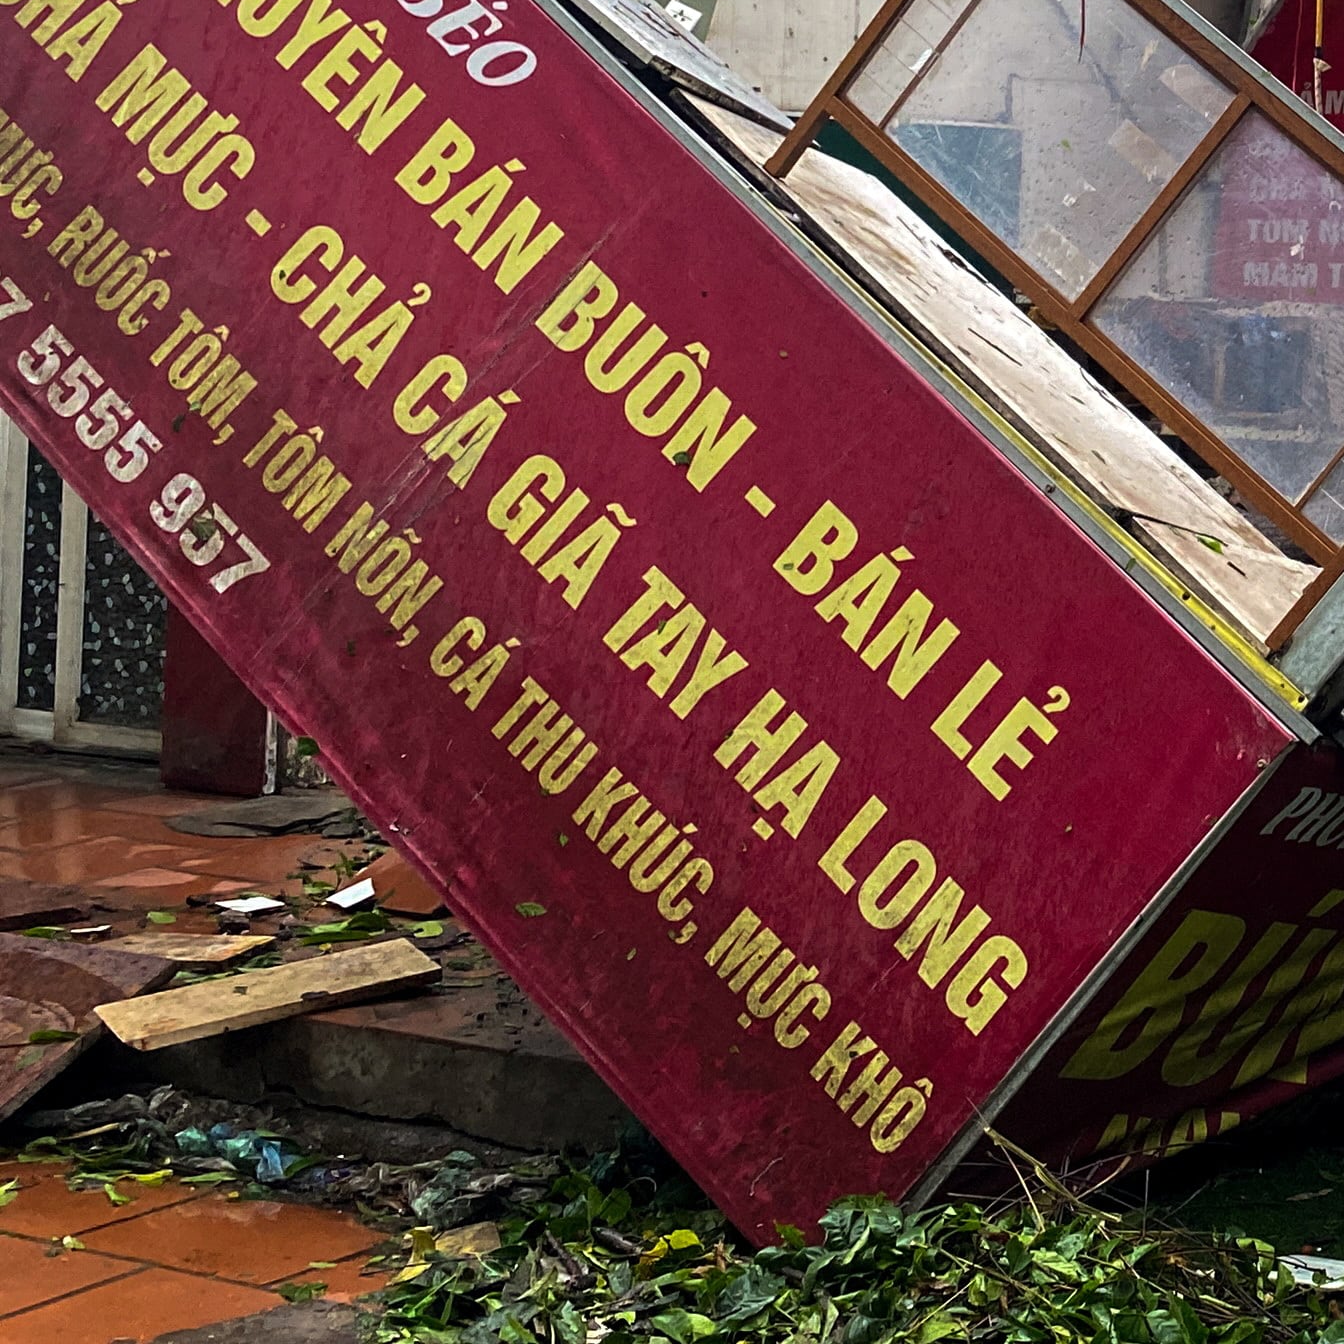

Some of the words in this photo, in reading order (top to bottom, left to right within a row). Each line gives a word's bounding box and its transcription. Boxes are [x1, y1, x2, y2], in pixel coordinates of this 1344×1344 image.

[15, 323, 164, 485] 5555
[149, 472, 272, 595] 957
[47, 204, 171, 337] RUỐC
[150, 307, 260, 446] TÔM,
[242, 407, 352, 535] TÔM
[326, 500, 446, 647] NÕN,
[428, 613, 523, 712] CÁ
[489, 675, 599, 796] THU
[570, 765, 716, 946] KHÚC,
[703, 904, 835, 1051] MỰC
[808, 1018, 935, 1155] KHÔ
[95, 43, 256, 211] MỰC
[270, 224, 431, 390] CHẢ
[392, 354, 522, 490] CÁ
[487, 453, 637, 610] GIÃ
[601, 565, 751, 721] TAY
[713, 687, 842, 842] HẠ
[817, 794, 1030, 1037] LONG
[394, 117, 566, 296] BÁN
[536, 260, 758, 494] BUÔN
[772, 499, 962, 702] BÁN
[930, 660, 1070, 803] LẺ
